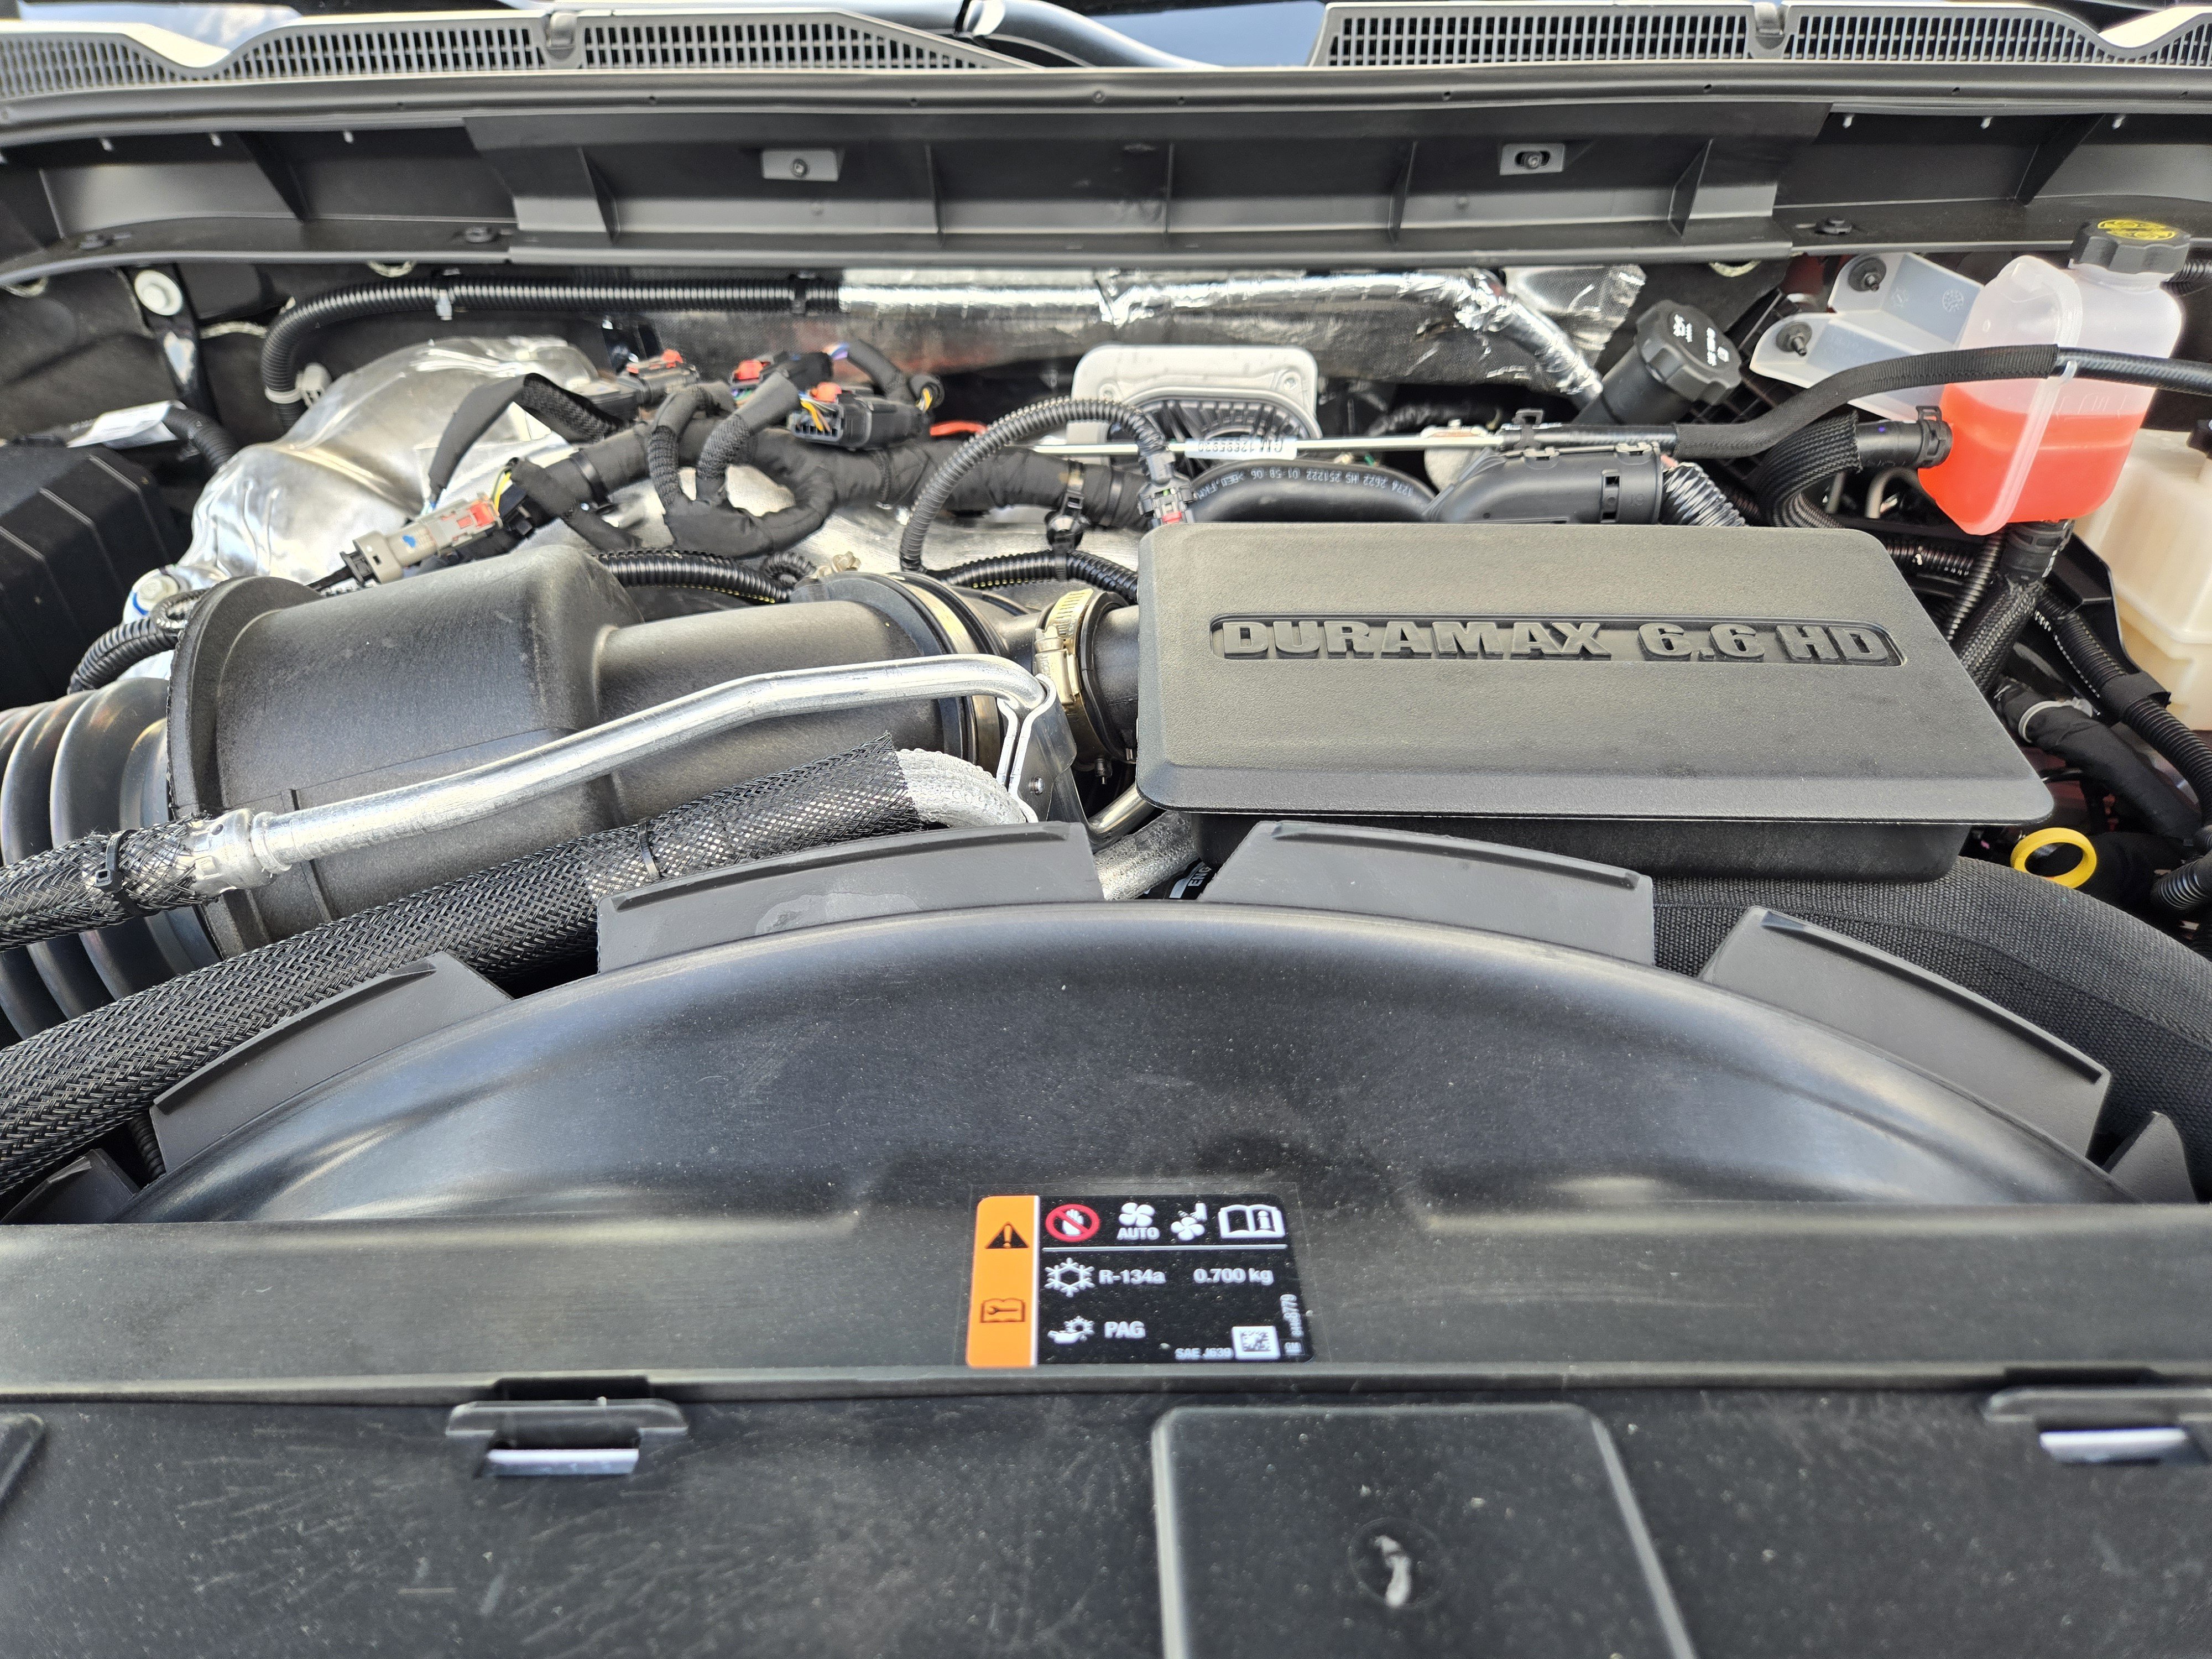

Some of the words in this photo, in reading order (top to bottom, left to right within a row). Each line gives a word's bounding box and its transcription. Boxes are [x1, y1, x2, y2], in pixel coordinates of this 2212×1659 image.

[1306, 468, 1342, 482] 251222
[1345, 472, 1359, 484] HS
[1222, 620, 1611, 659] DURAMAX
[1637, 623, 1765, 661] 6.6
[1775, 624, 1889, 662] HD
[1117, 1227, 1160, 1240] AUTO
[1098, 1269, 1166, 1285] R-134a
[1193, 1267, 1246, 1284] 0.700
[1248, 1267, 1274, 1286] kg
[1104, 1321, 1146, 1339] PAG
[1175, 1348, 1202, 1360] SAE
[1202, 1347, 1235, 1360] J639
[1284, 1342, 1302, 1354] GM
